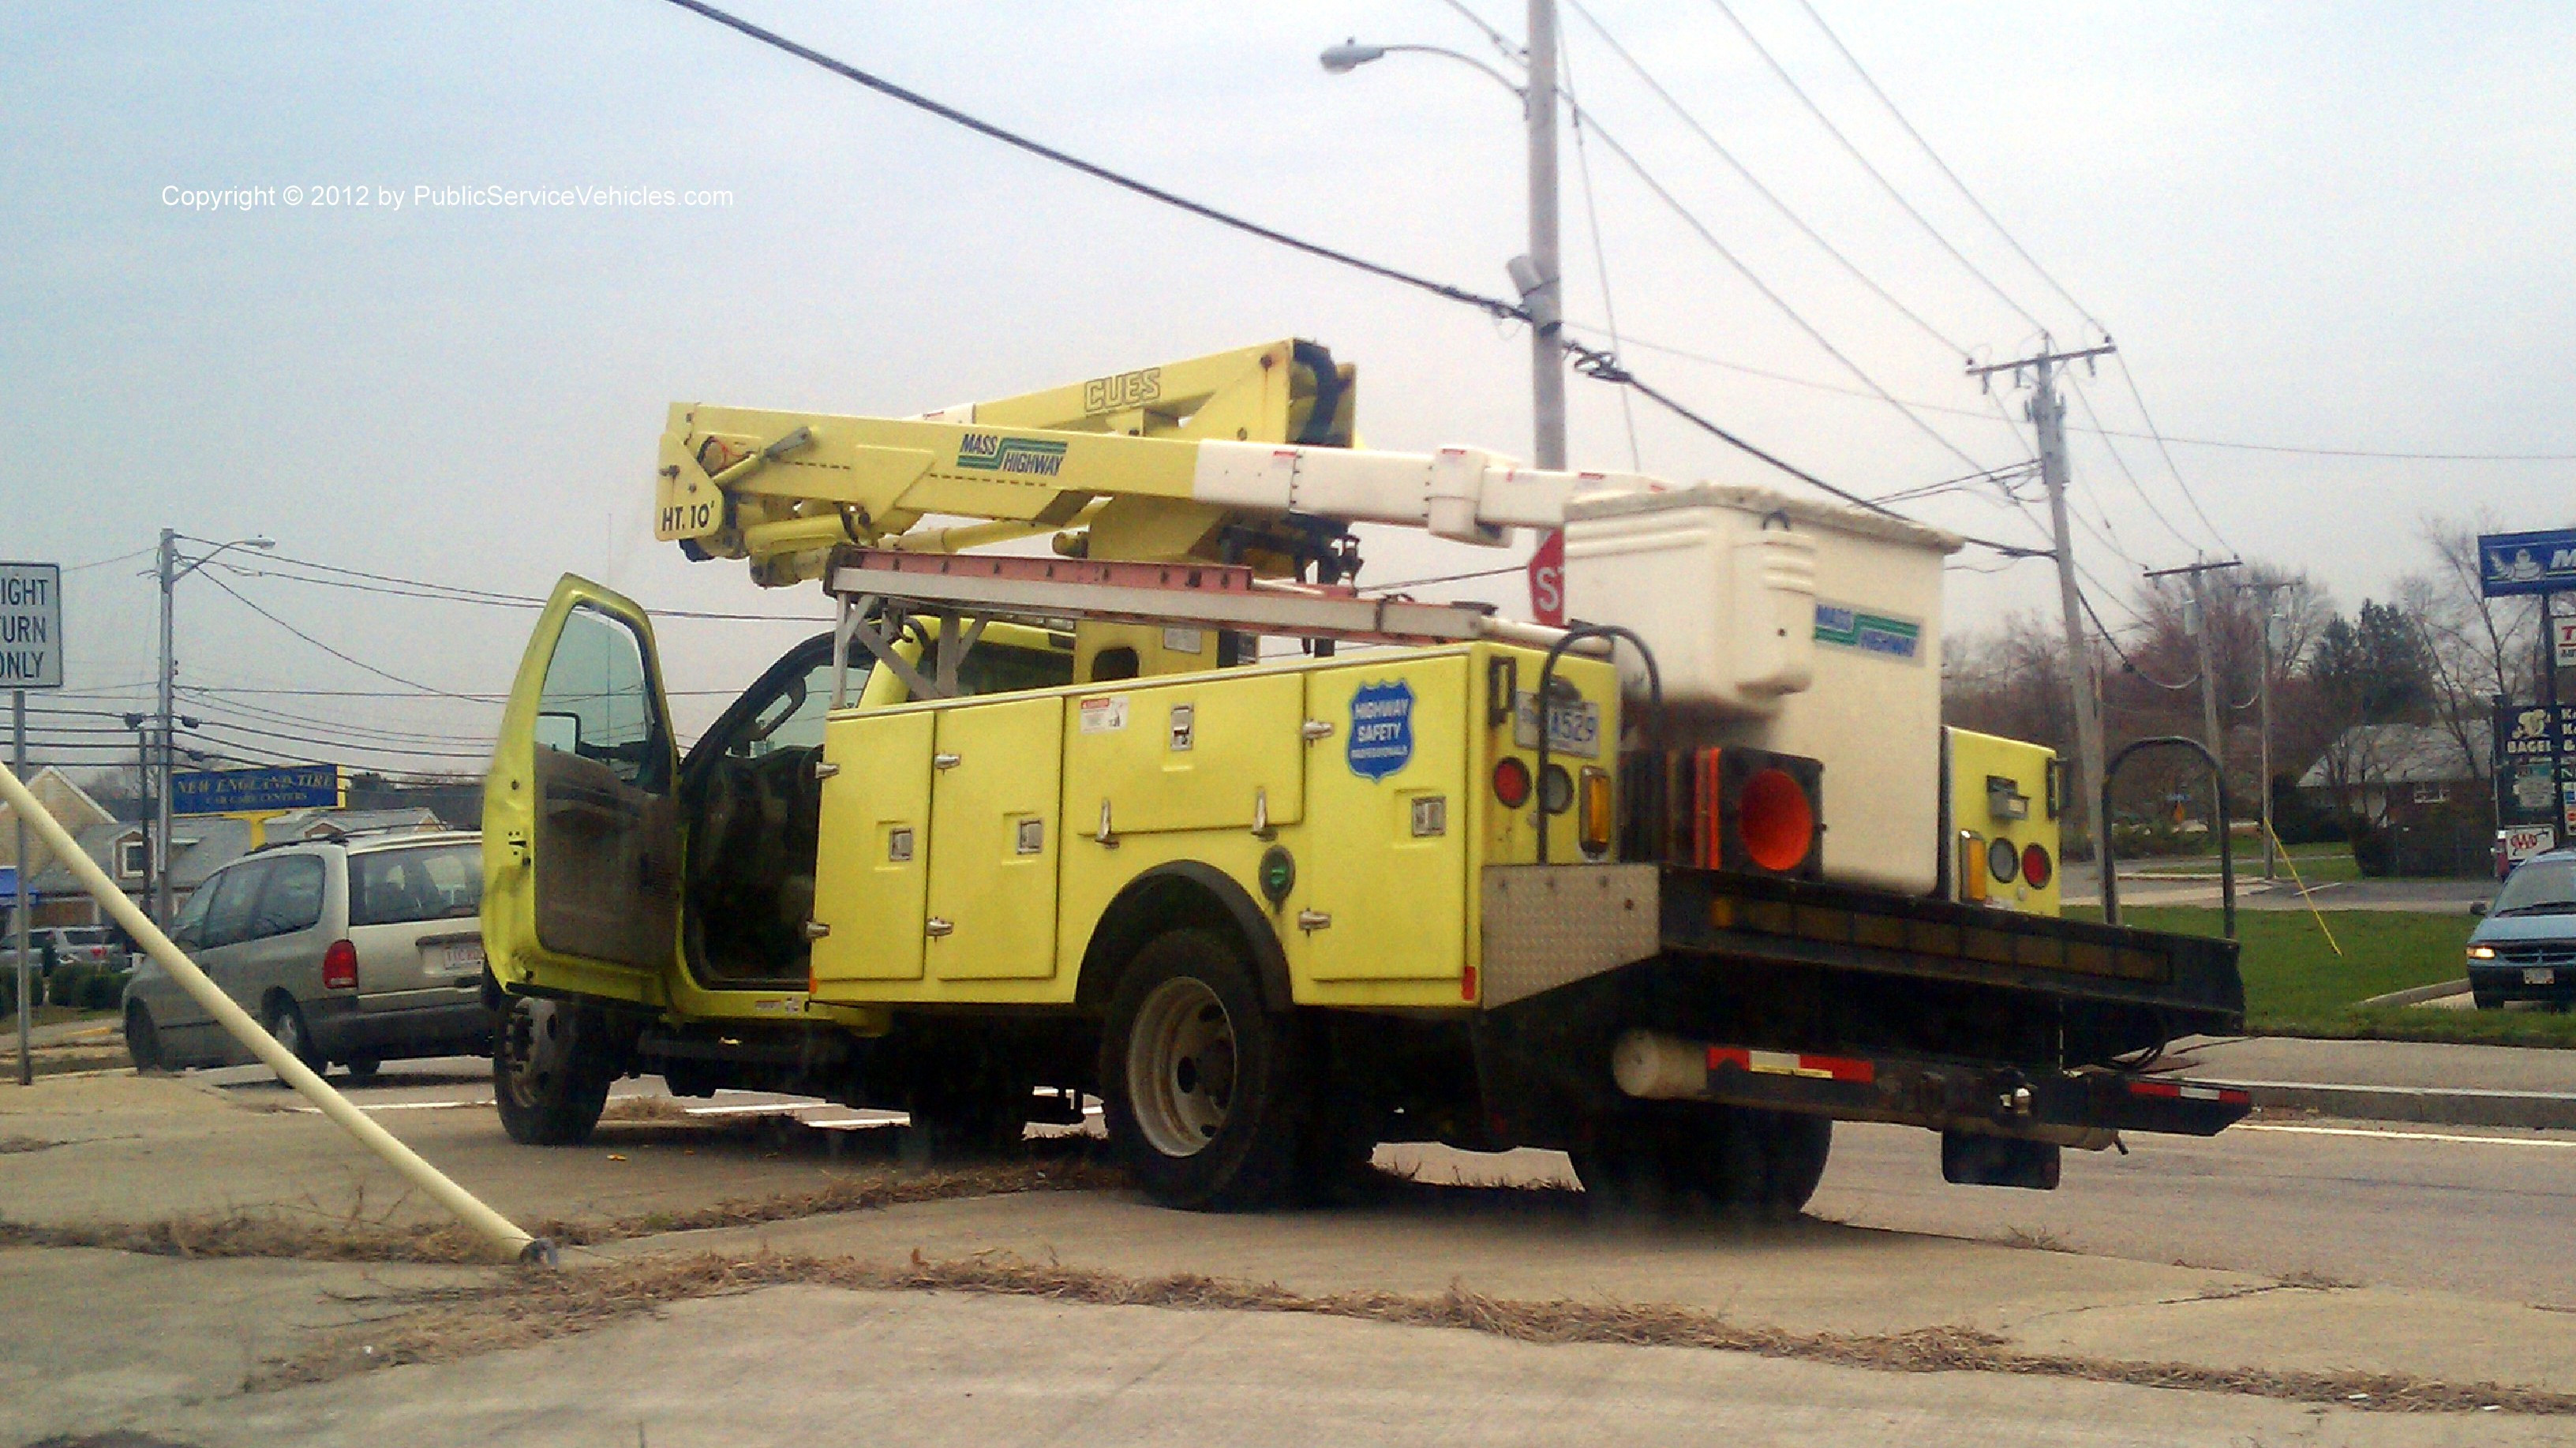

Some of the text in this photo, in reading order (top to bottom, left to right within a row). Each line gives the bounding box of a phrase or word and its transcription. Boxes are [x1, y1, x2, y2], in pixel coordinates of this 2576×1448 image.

[1084, 367, 1160, 412] CUES
[960, 433, 998, 455] MASS
[1002, 451, 1064, 476] HIGHWAY
[661, 506, 685, 531] HT.
[0, 615, 47, 643] URN
[1816, 604, 1852, 630] MASS
[1859, 630, 1917, 657] HIGHWAY
[1354, 698, 1410, 719] HIGHWAY
[1357, 722, 1402, 742] SAFETY
[178, 773, 335, 794] NEW ENGLAND TIRE
